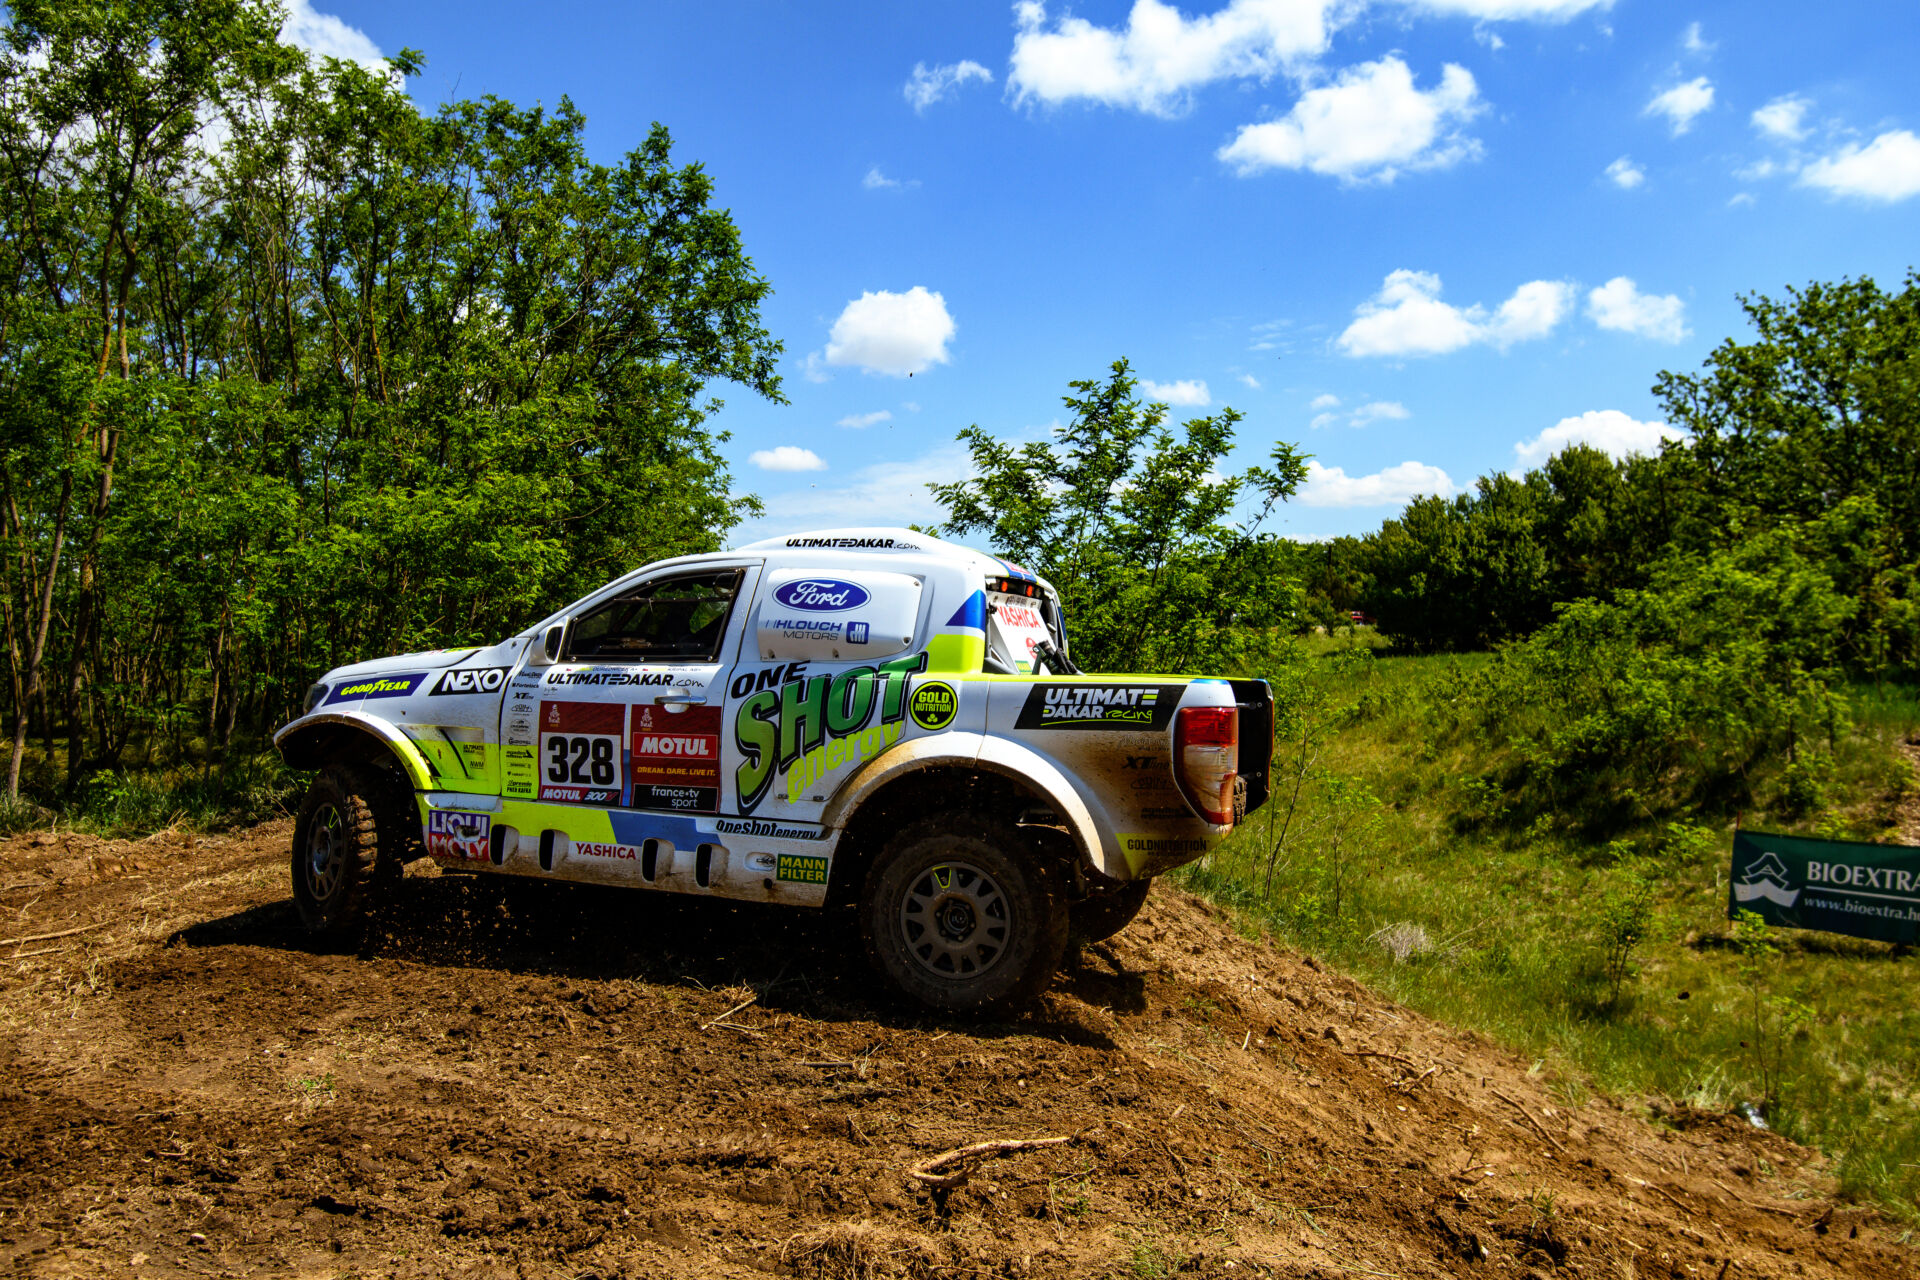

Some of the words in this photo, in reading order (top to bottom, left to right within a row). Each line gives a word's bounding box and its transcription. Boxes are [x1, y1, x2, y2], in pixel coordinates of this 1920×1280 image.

[789, 581, 849, 606] Ford
[776, 620, 842, 631] HLOUCH
[997, 605, 1042, 629] YASHICA
[783, 630, 839, 641] MOTORS
[341, 679, 411, 696] GOODYEAR
[441, 669, 504, 692] NEXO
[731, 660, 810, 699] ONE
[918, 691, 950, 704] GOLD
[1045, 688, 1160, 706] ULTIMATE
[915, 702, 952, 713] NUTRITION
[1042, 705, 1104, 719] DAKAR
[1105, 705, 1153, 724] racing
[735, 651, 929, 817] SHOT
[640, 736, 710, 756] MOTUL
[547, 736, 615, 786] 328
[786, 720, 904, 804] energy
[637, 766, 666, 775] DREAM.
[666, 767, 689, 776] DARE.
[689, 768, 706, 776] LIVE
[706, 769, 716, 777] IT.
[542, 788, 581, 801] MOTUL
[584, 790, 620, 802] 300V
[671, 798, 698, 809] sport
[431, 812, 488, 838] LIQUI
[431, 835, 489, 859] MOLY
[575, 842, 637, 861] YASHICA
[1127, 837, 1208, 852] GOLDNUTRITION
[780, 856, 826, 871] MANN
[780, 867, 825, 882] FILTER
